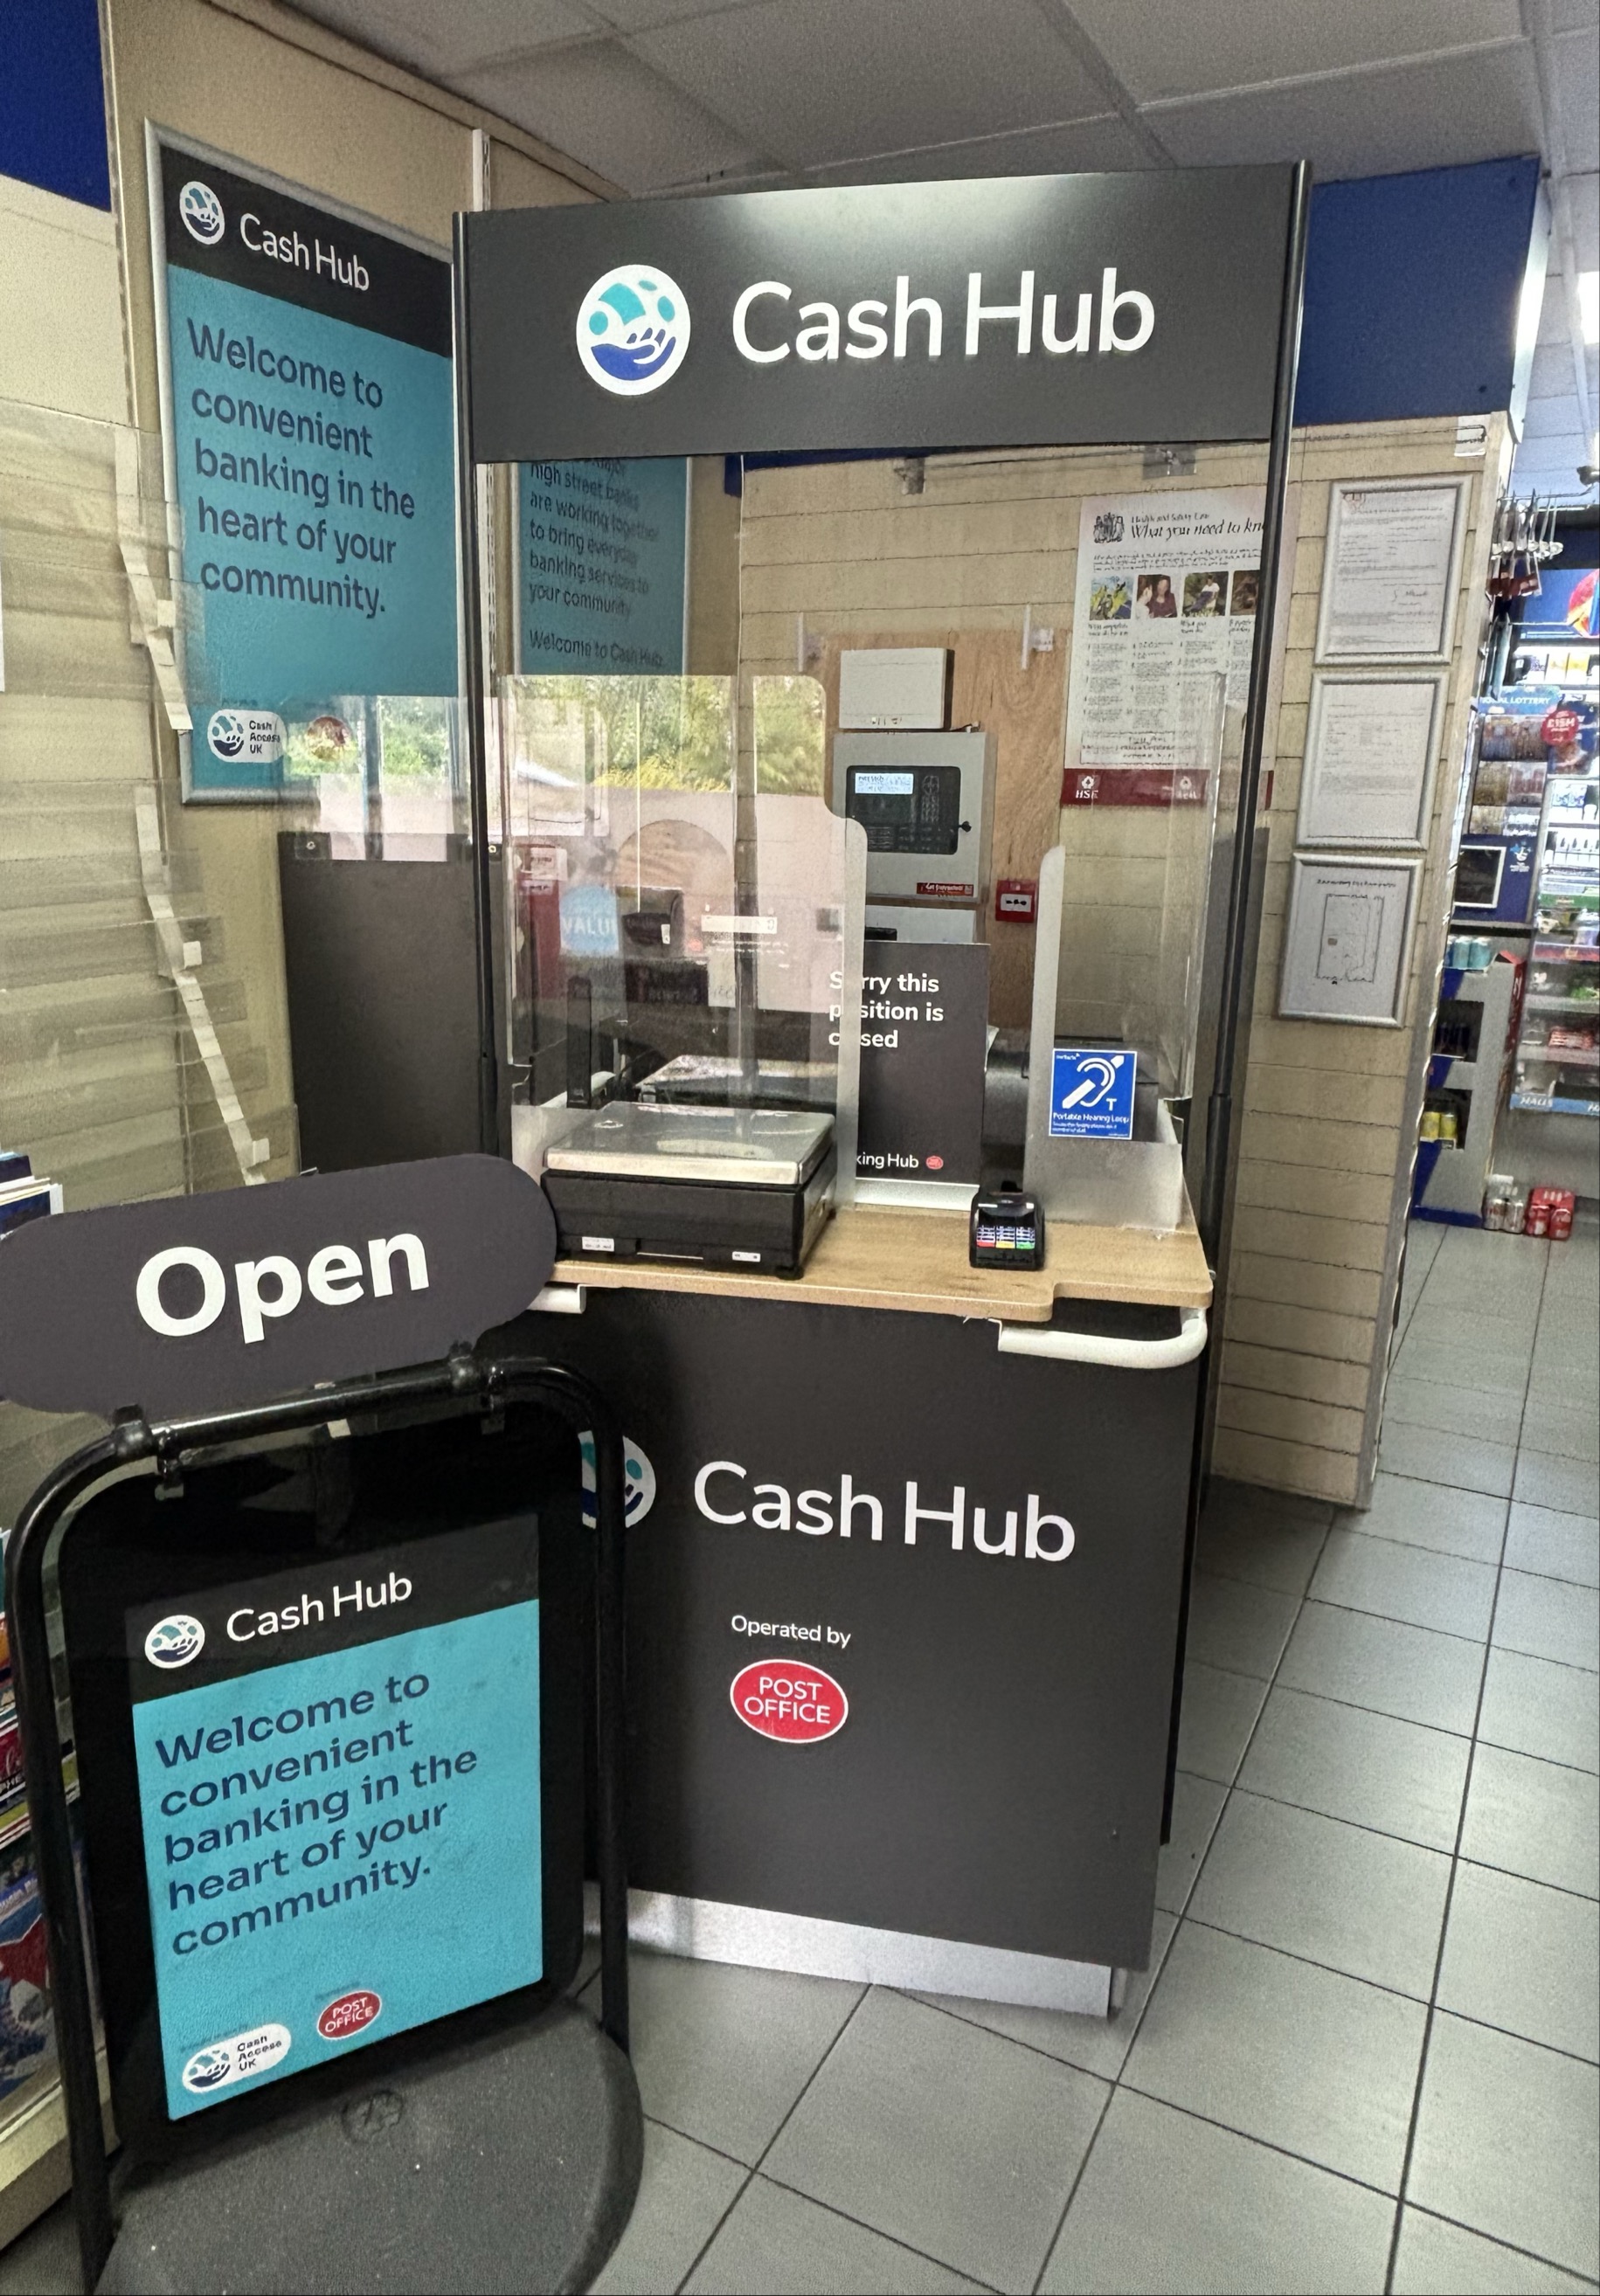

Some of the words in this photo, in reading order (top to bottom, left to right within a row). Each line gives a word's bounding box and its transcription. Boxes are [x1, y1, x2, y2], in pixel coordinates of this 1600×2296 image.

[239, 212, 310, 270] Cash
[315, 239, 371, 291] Hub
[731, 275, 944, 363] Cash
[965, 266, 1156, 357] Hub
[187, 317, 346, 398] Welcome
[352, 370, 383, 409] to
[191, 388, 373, 459] convenient
[195, 439, 329, 508] banking
[338, 469, 364, 508] in
[371, 481, 415, 520] the
[530, 491, 552, 512] are
[197, 495, 288, 546] heart
[296, 521, 328, 552] of
[335, 529, 397, 564] your
[530, 518, 545, 540] to
[548, 523, 585, 556] bring
[1194, 518, 1224, 536] need
[530, 549, 585, 584] banking
[200, 561, 386, 619] community.
[529, 583, 560, 605] your
[530, 629, 592, 657] Welcome
[594, 640, 608, 659] to
[249, 720, 273, 730] Cash
[249, 732, 281, 743] Access
[249, 744, 262, 754] UK
[829, 970, 892, 995] Srry
[897, 972, 940, 992] this
[828, 999, 919, 1022] psition
[925, 1001, 944, 1022] is
[828, 1029, 899, 1048] csed
[1052, 1111, 1083, 1122] Portable
[1083, 1113, 1111, 1124] Hearing
[1105, 1097, 1118, 1112] T
[887, 1152, 919, 1169] Hub
[135, 1232, 430, 1345] Open
[694, 1461, 883, 1541] Cash
[904, 1481, 1076, 1562] Hub
[225, 1594, 325, 1642] Cash
[332, 1572, 412, 1618] Hub
[731, 1614, 821, 1642] Operated
[827, 1625, 852, 1649] by
[758, 1676, 823, 1702] POST
[155, 1689, 376, 1769] Welcome
[384, 1673, 430, 1705] to
[744, 1696, 831, 1725] OFFICE
[160, 1719, 415, 1817] convenient
[164, 1787, 350, 1866] banking
[360, 1773, 399, 1806] in
[409, 1749, 479, 1789] the
[168, 1848, 290, 1911] heart
[301, 1828, 347, 1868] of
[355, 1798, 448, 1860] your
[171, 1854, 431, 1956] community.
[325, 2007, 374, 2033] OFFICE
[333, 1997, 369, 2019] POST
[238, 2035, 268, 2051] Cash
[239, 2040, 282, 2062] Access
[239, 2058, 257, 2071] UK
